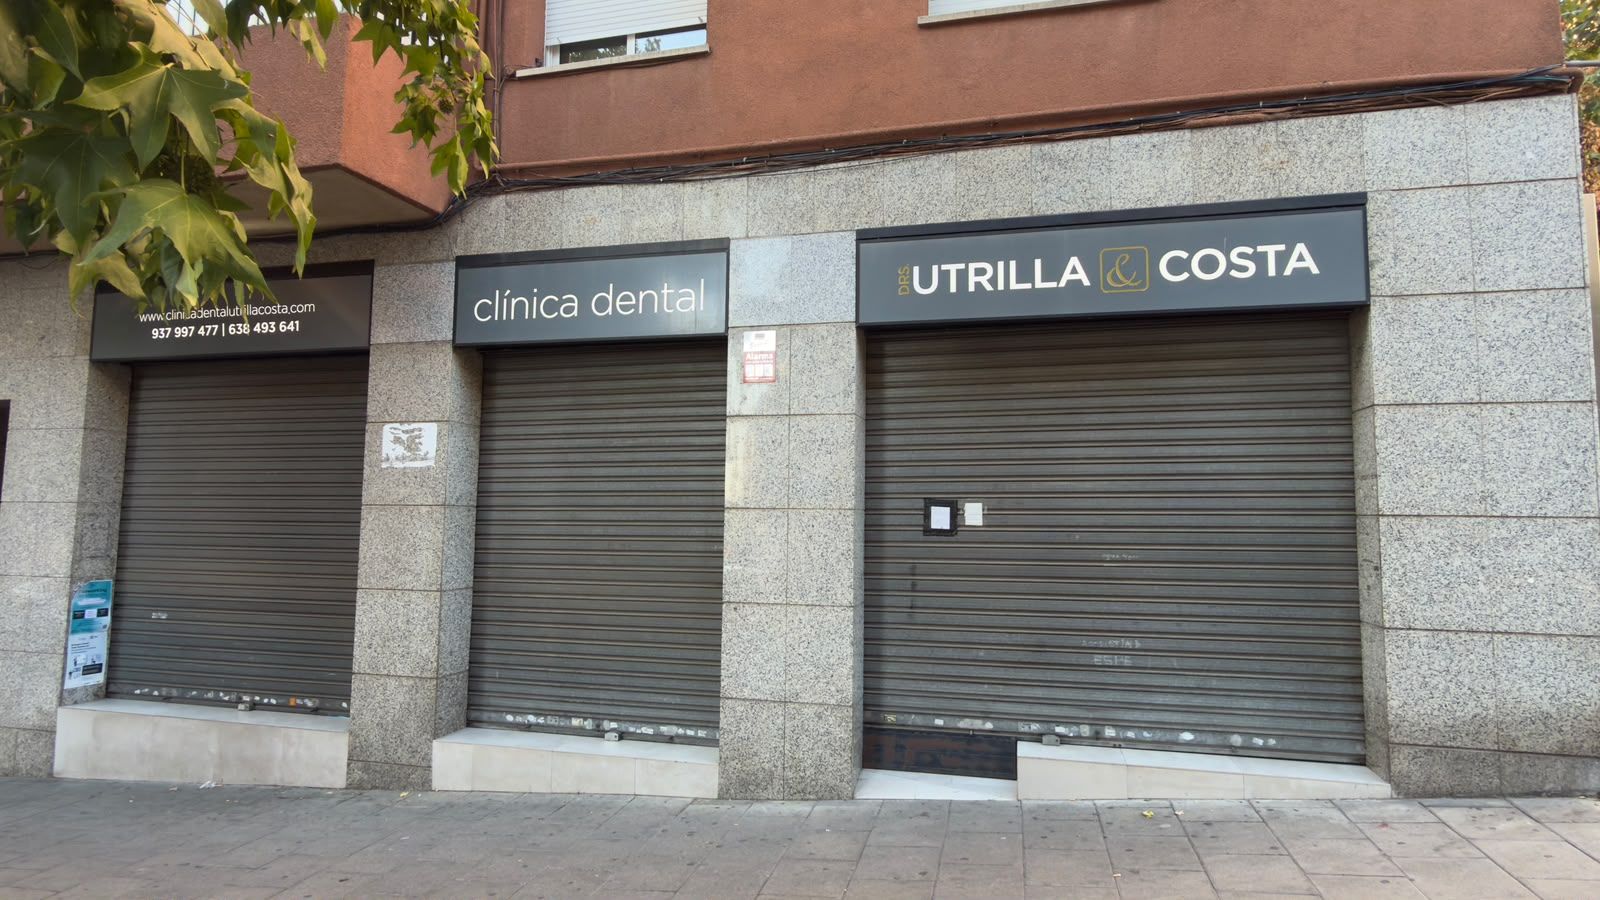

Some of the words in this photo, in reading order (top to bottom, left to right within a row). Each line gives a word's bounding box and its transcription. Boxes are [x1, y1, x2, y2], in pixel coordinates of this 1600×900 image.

[912, 255, 1091, 295] UTRILLA
[1106, 253, 1142, 287] &
[1158, 242, 1320, 283] COSTA
[473, 288, 579, 322] clínica
[591, 278, 705, 316] dental
[151, 328, 172, 339] 937
[174, 326, 195, 338] 997
[197, 325, 218, 337] 477
[228, 323, 250, 335] 638
[253, 321, 276, 333] 493
[279, 320, 300, 332] 641
